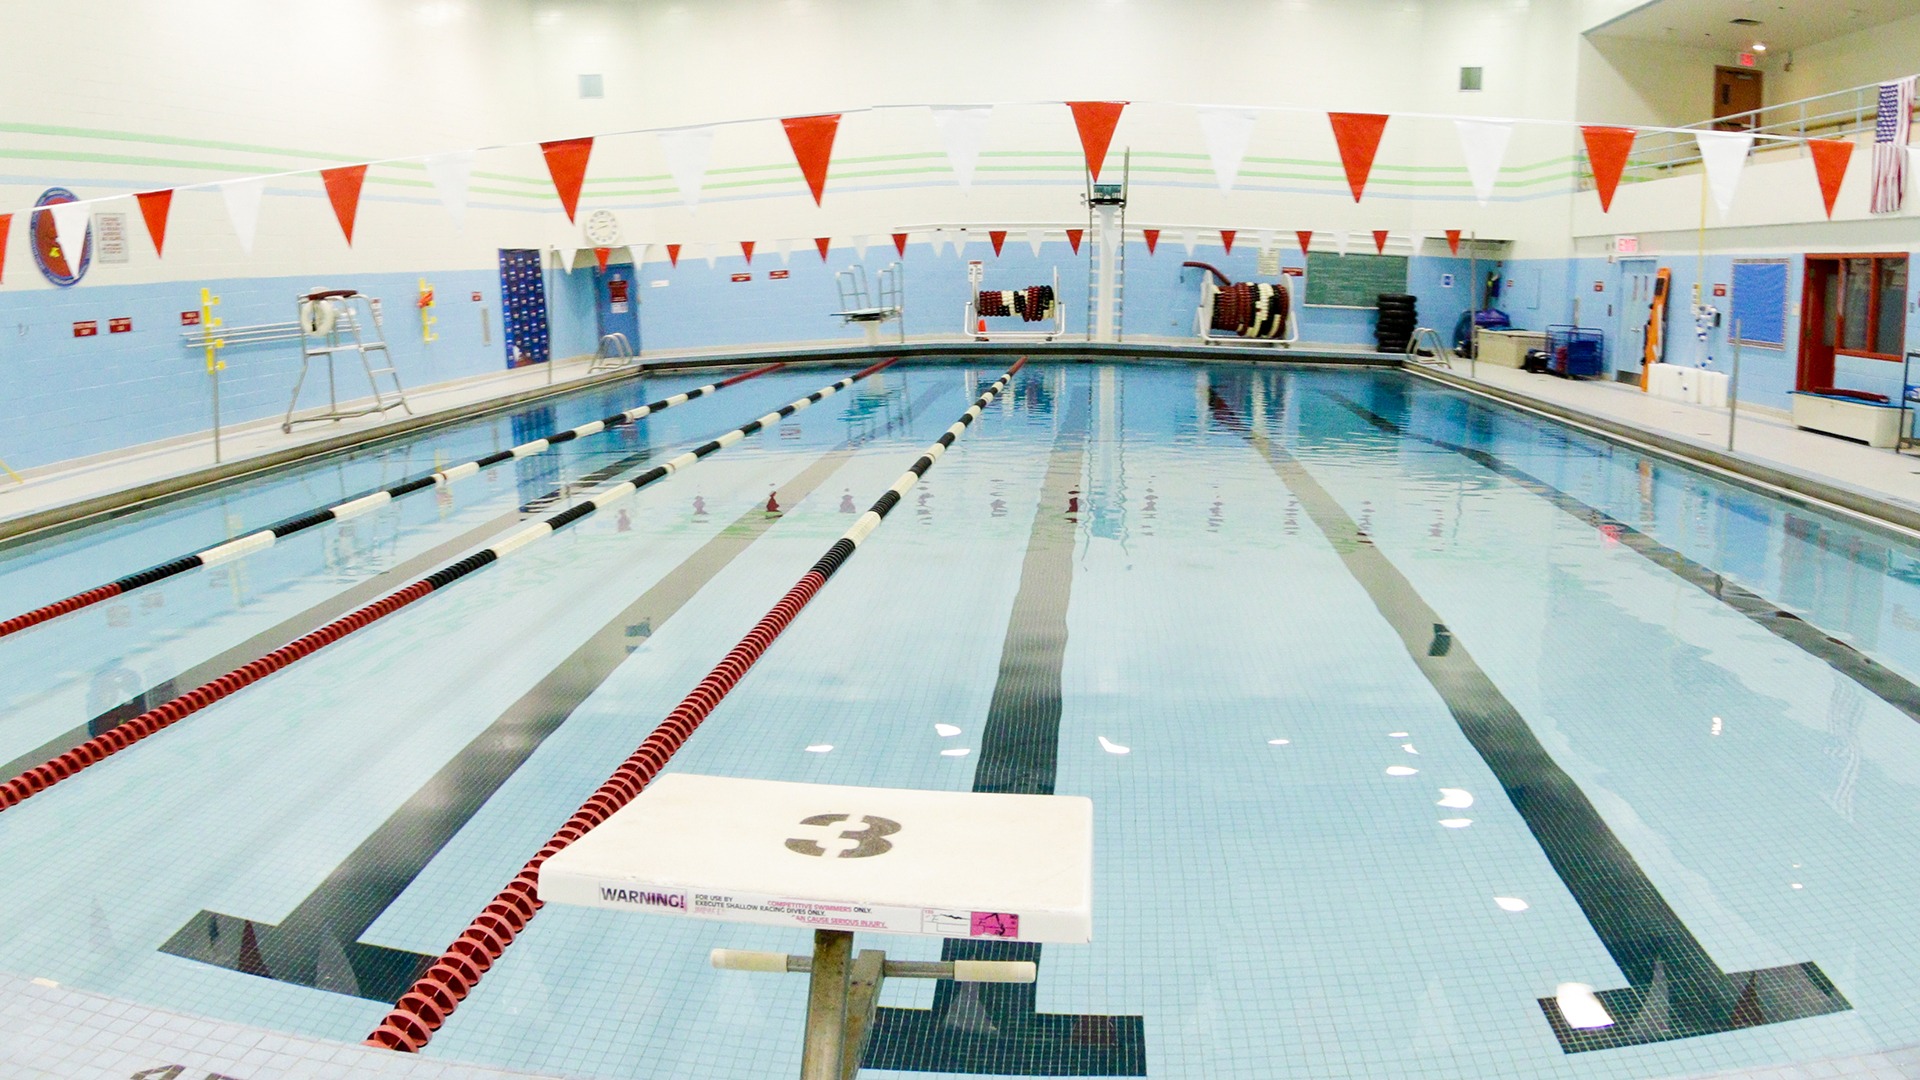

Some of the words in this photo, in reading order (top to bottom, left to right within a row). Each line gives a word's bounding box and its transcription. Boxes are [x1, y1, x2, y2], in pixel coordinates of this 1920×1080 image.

[784, 813, 902, 858] 3
[601, 887, 684, 909] WARNING!
[695, 900, 724, 908] EXECUTE
[726, 902, 758, 910] SHALLOW
[786, 907, 806, 915] DIVES
[767, 900, 813, 909] COMPETITIVE
[814, 904, 852, 912] SWIMMERS
[853, 906, 872, 914] ONLY.
[831, 917, 860, 926] SERIOUS
